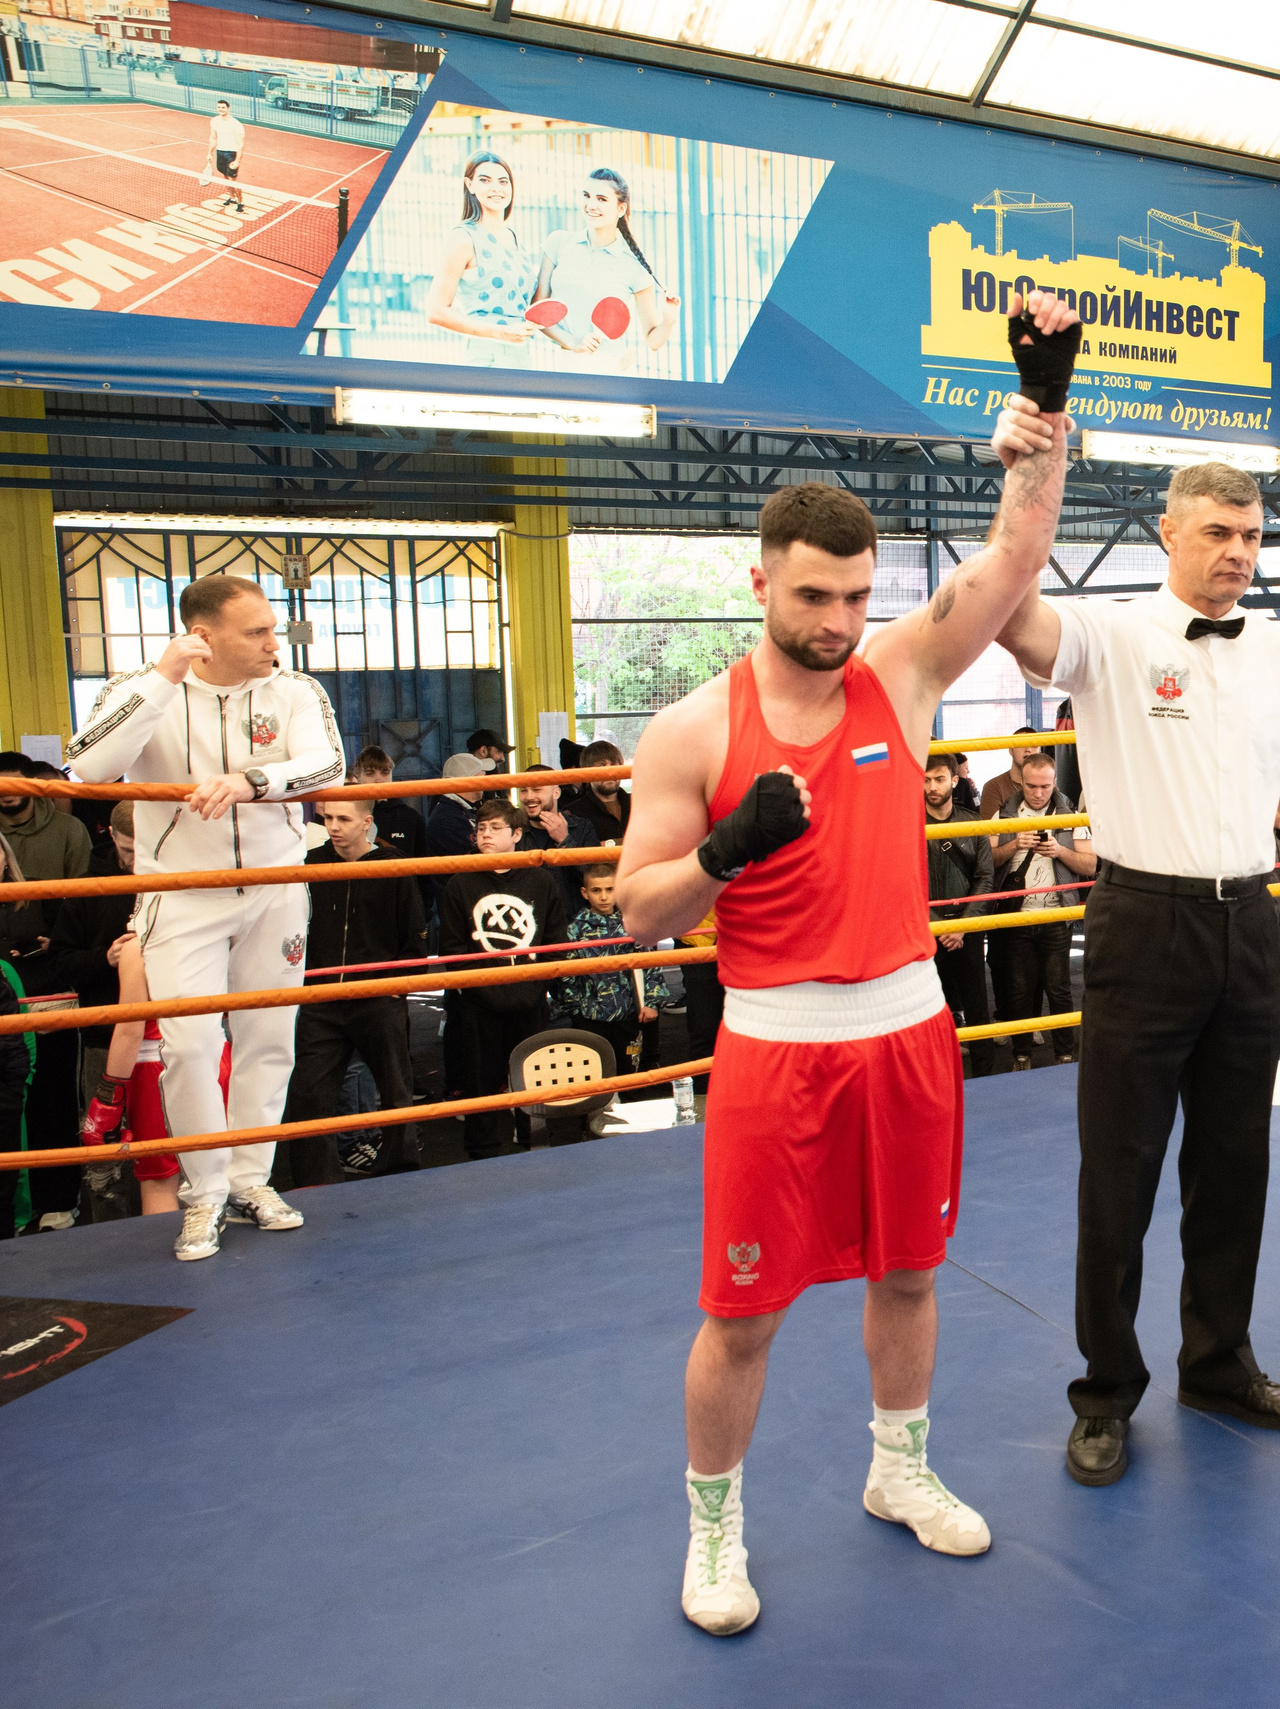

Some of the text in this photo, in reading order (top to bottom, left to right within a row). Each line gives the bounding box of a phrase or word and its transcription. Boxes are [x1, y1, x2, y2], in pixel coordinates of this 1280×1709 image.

[961, 268, 1240, 342] ЮгойИнвест
[1098, 341, 1178, 365] КОМПАНИЙ
[1102, 374, 1132, 389] 2003
[922, 376, 1272, 431] Нас реендуют друзьям!
[0, 1325, 65, 1357] IGHT
